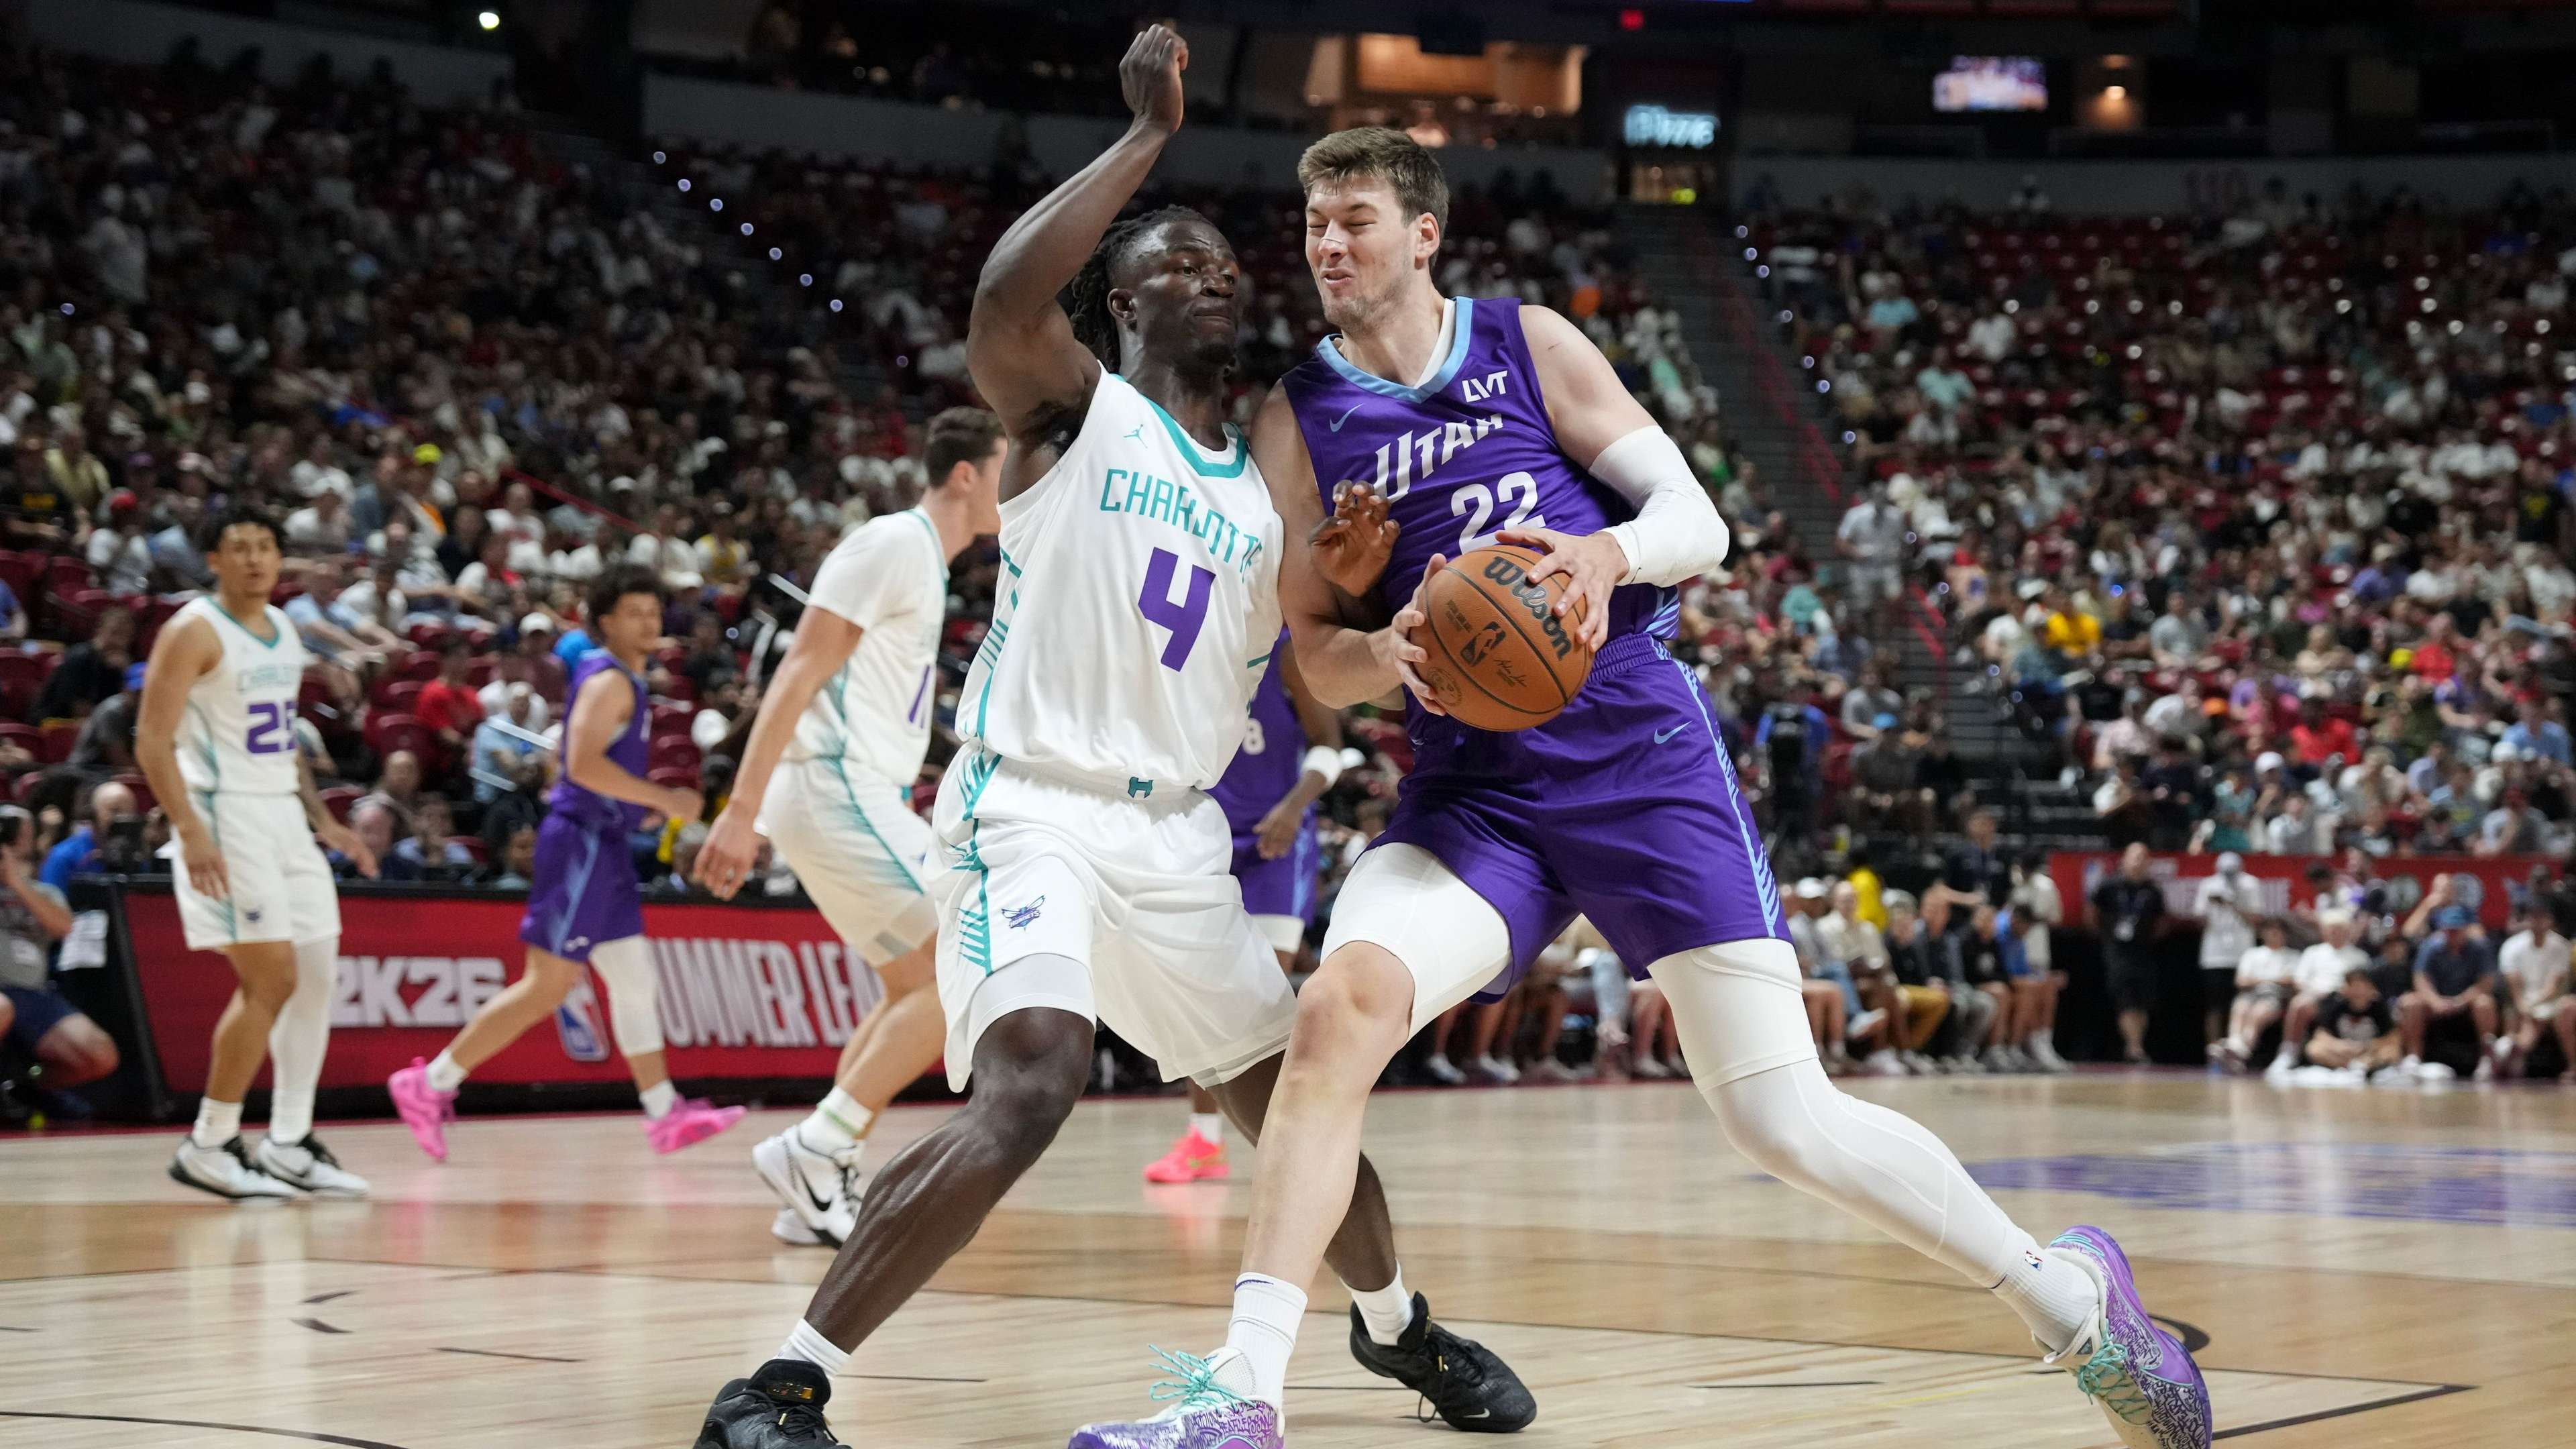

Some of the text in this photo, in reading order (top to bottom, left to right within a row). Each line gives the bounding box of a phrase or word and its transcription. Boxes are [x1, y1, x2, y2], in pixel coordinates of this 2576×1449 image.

[1462, 370, 1508, 402] LVT
[1451, 471, 1546, 555] 22
[1138, 546, 1217, 673] 4
[330, 955, 508, 1028] 2K26
[654, 938, 888, 1049] UMMER LEA
